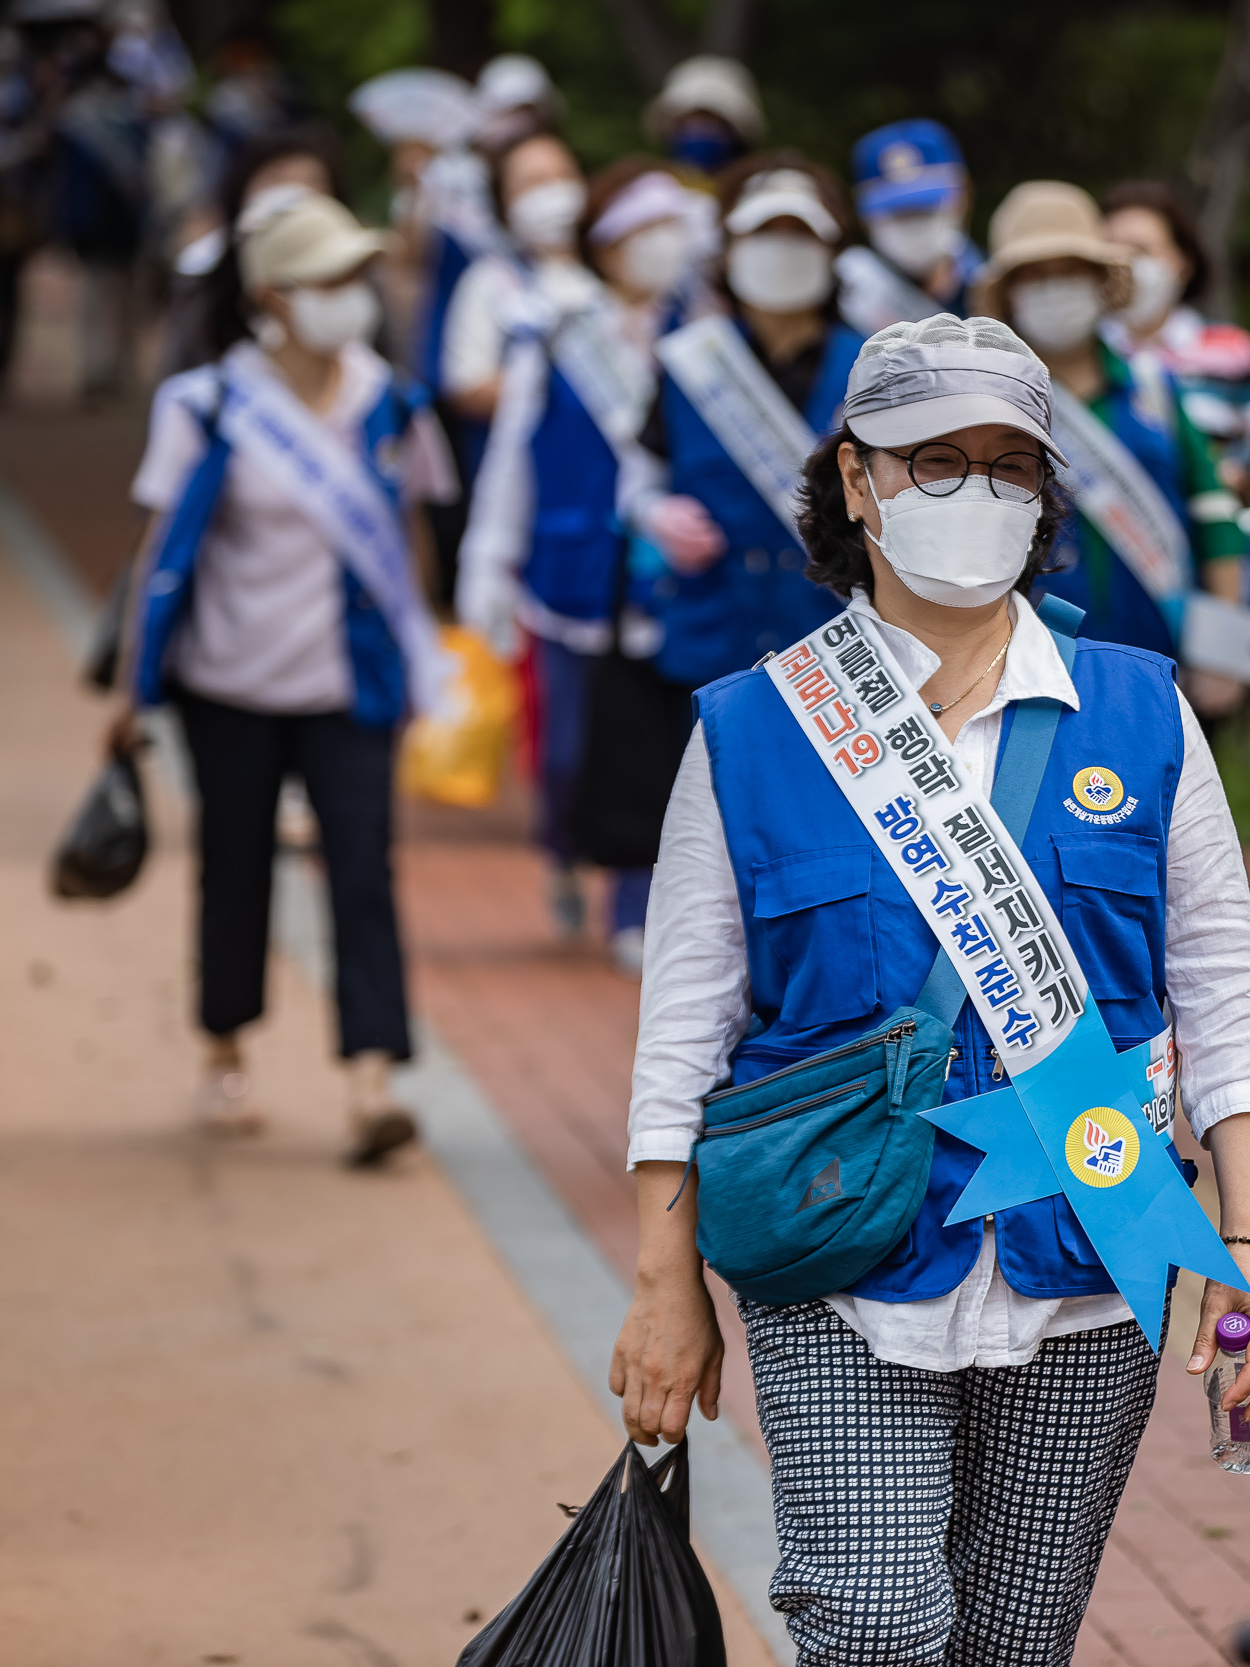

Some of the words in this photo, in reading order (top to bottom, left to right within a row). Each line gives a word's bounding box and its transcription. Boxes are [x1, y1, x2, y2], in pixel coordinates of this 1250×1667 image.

[781, 644, 880, 775] 코로나19
[823, 616, 900, 714] 여름철
[885, 716, 957, 796] 행락
[942, 806, 1082, 1028] 질서지키기
[811, 1182, 836, 1200] K2
